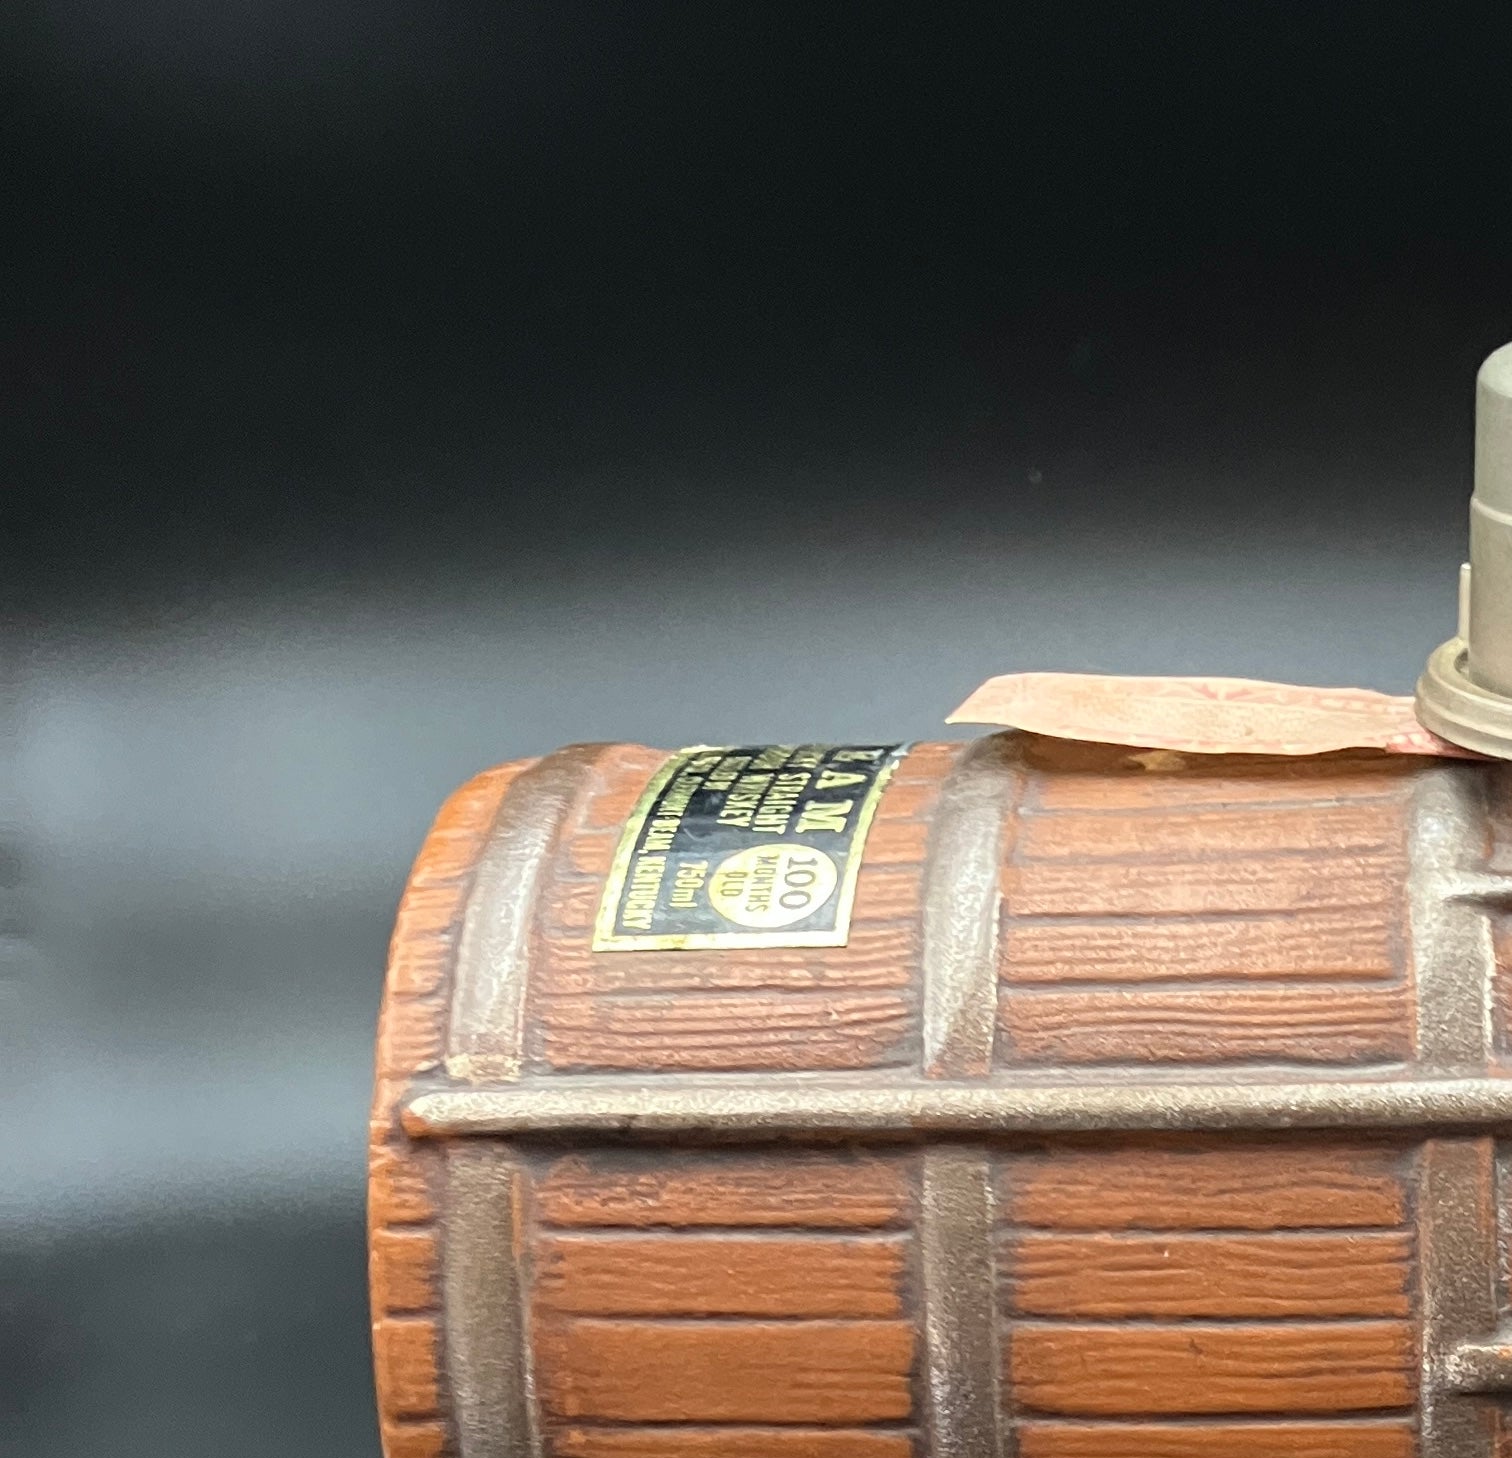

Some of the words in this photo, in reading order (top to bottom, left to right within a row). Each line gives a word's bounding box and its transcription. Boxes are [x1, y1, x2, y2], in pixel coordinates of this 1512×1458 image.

[623, 855, 666, 929] KENTUCKY
[719, 871, 749, 898] OLD
[745, 854, 780, 913] MONTHS
[779, 856, 819, 909] 100
